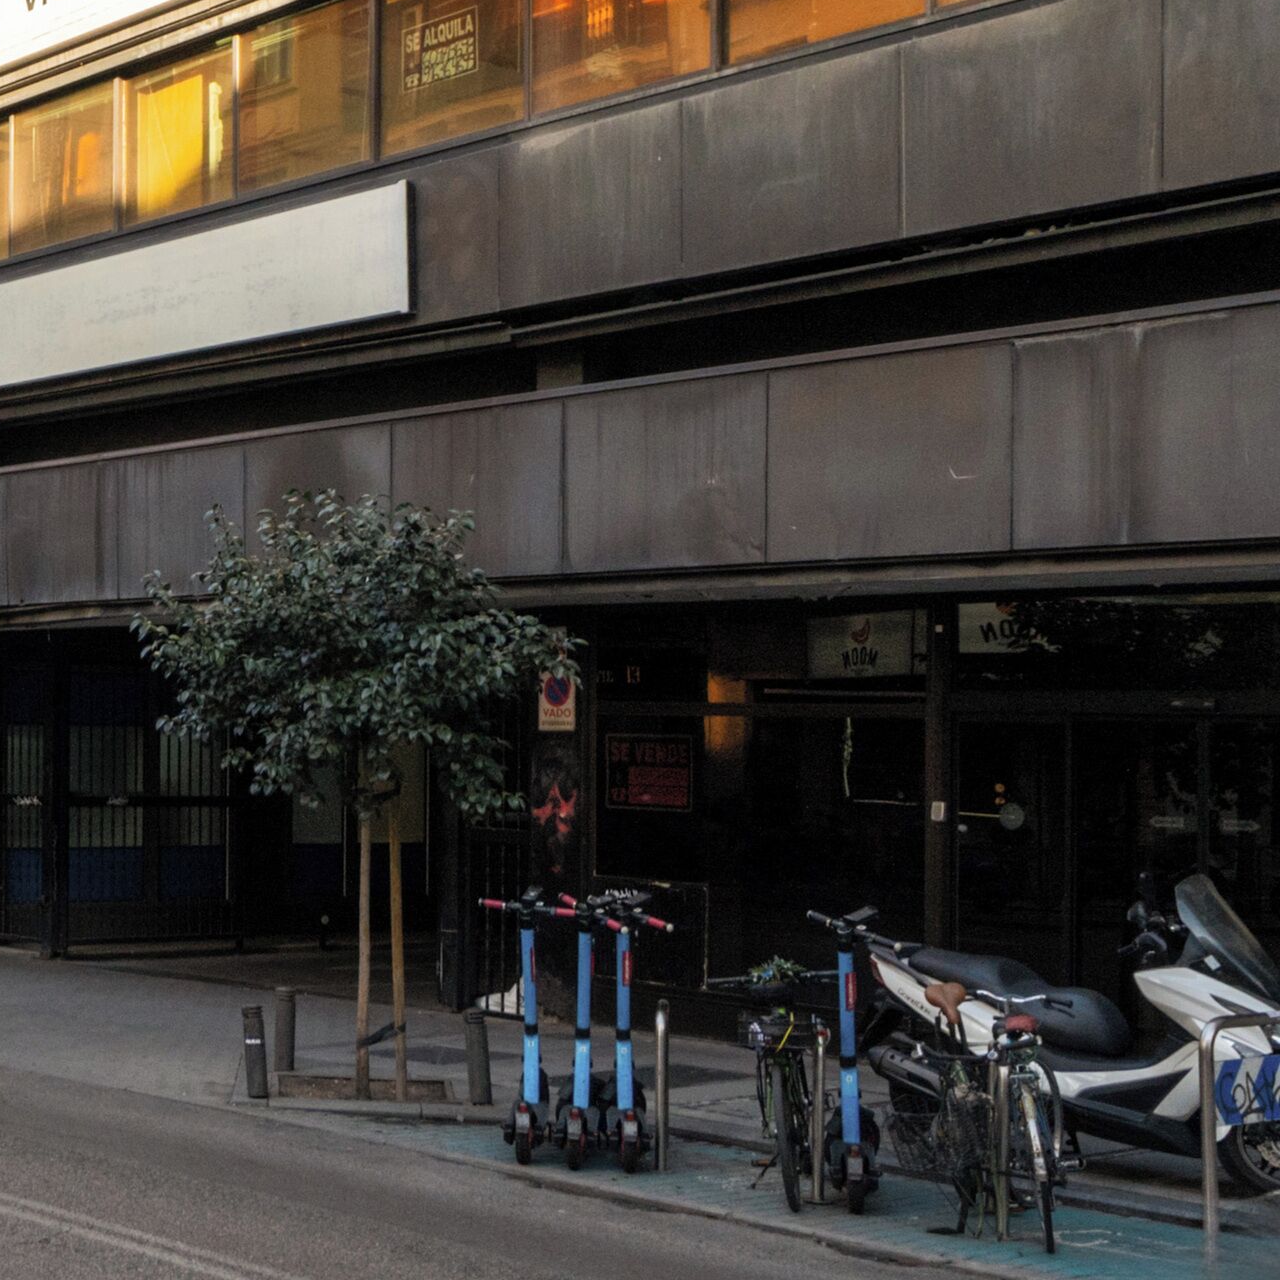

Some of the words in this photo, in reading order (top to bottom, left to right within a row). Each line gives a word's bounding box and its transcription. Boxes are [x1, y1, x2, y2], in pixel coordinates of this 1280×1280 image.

[405, 31, 421, 54] SE
[423, 14, 474, 49] ALQUILA
[543, 708, 572, 718] VADO
